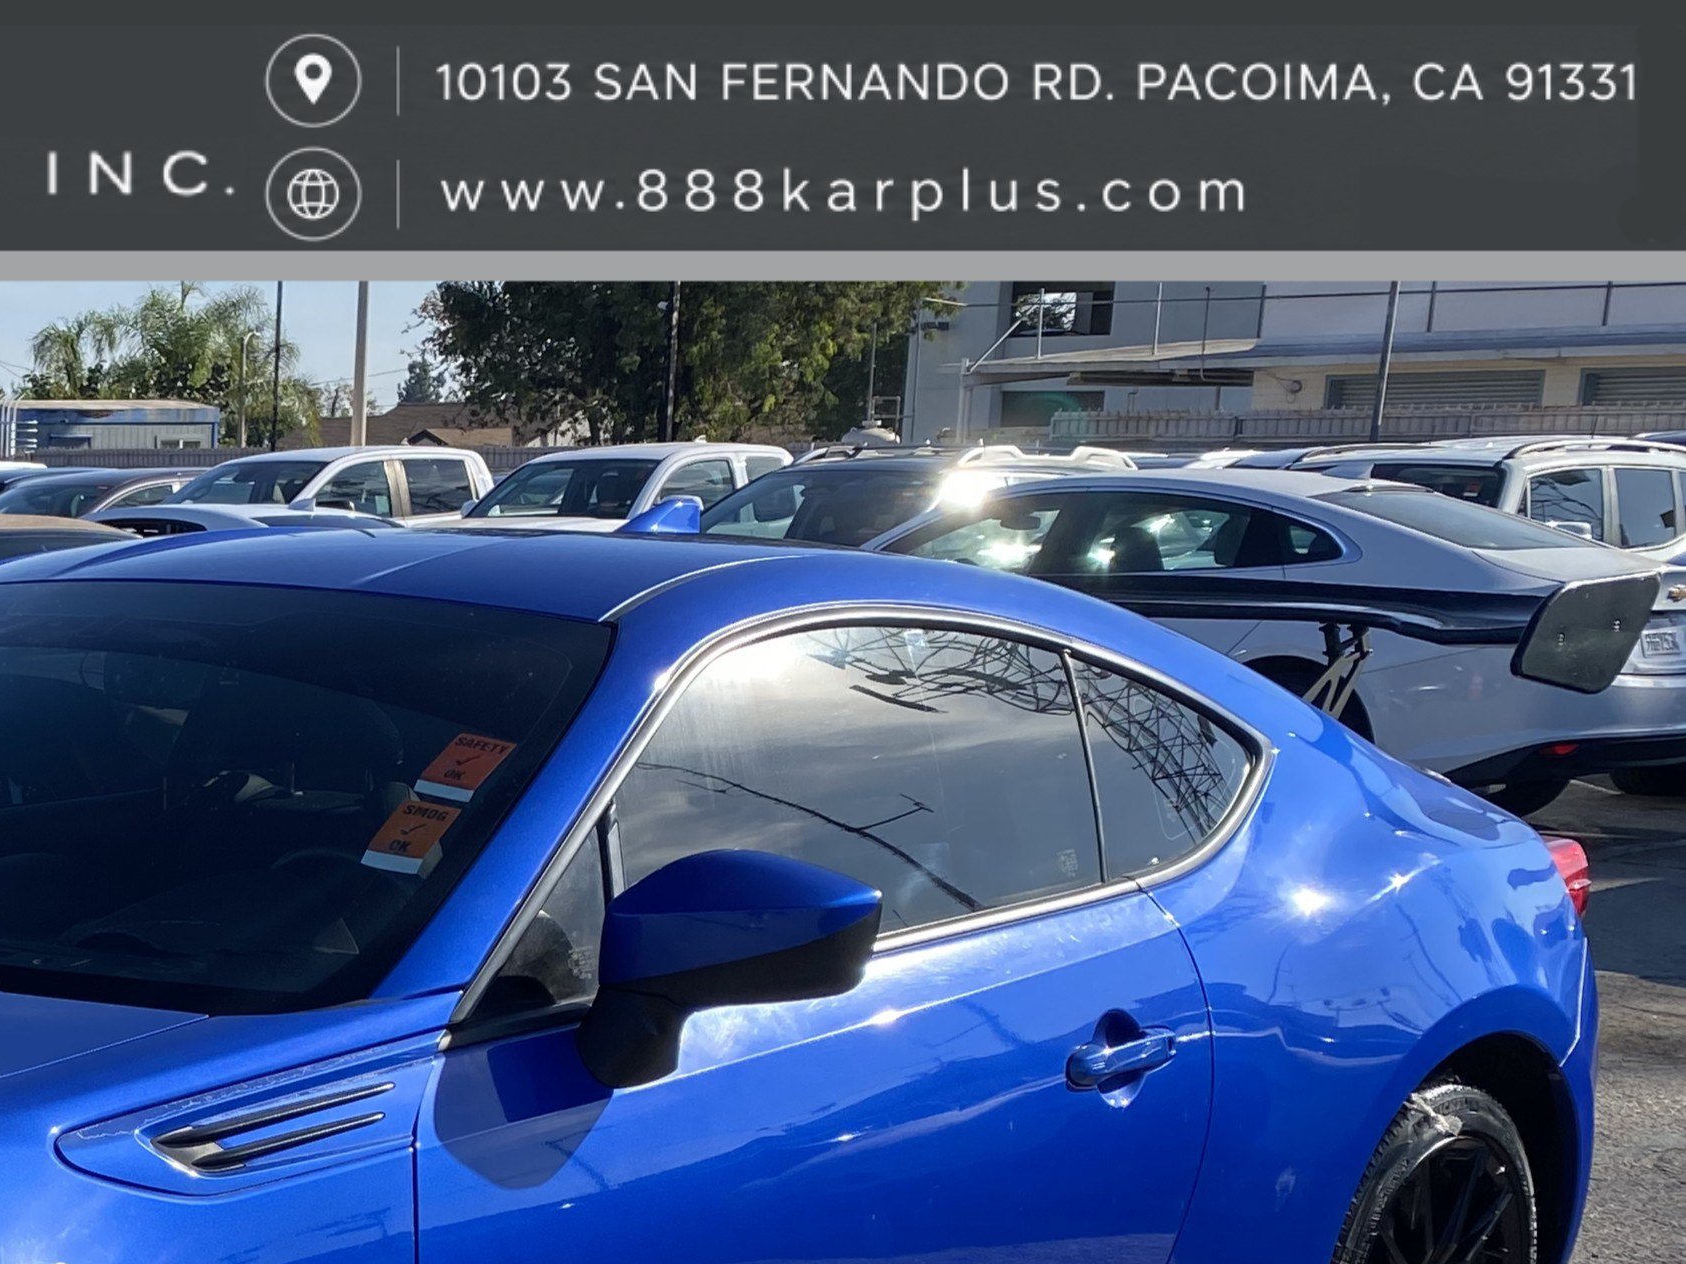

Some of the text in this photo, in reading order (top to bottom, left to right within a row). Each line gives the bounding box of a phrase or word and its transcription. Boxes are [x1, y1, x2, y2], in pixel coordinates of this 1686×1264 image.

[455, 737, 510, 754] SAFETY
[445, 769, 466, 780] OK
[404, 805, 448, 821] SMOG
[389, 839, 412, 853] OK
